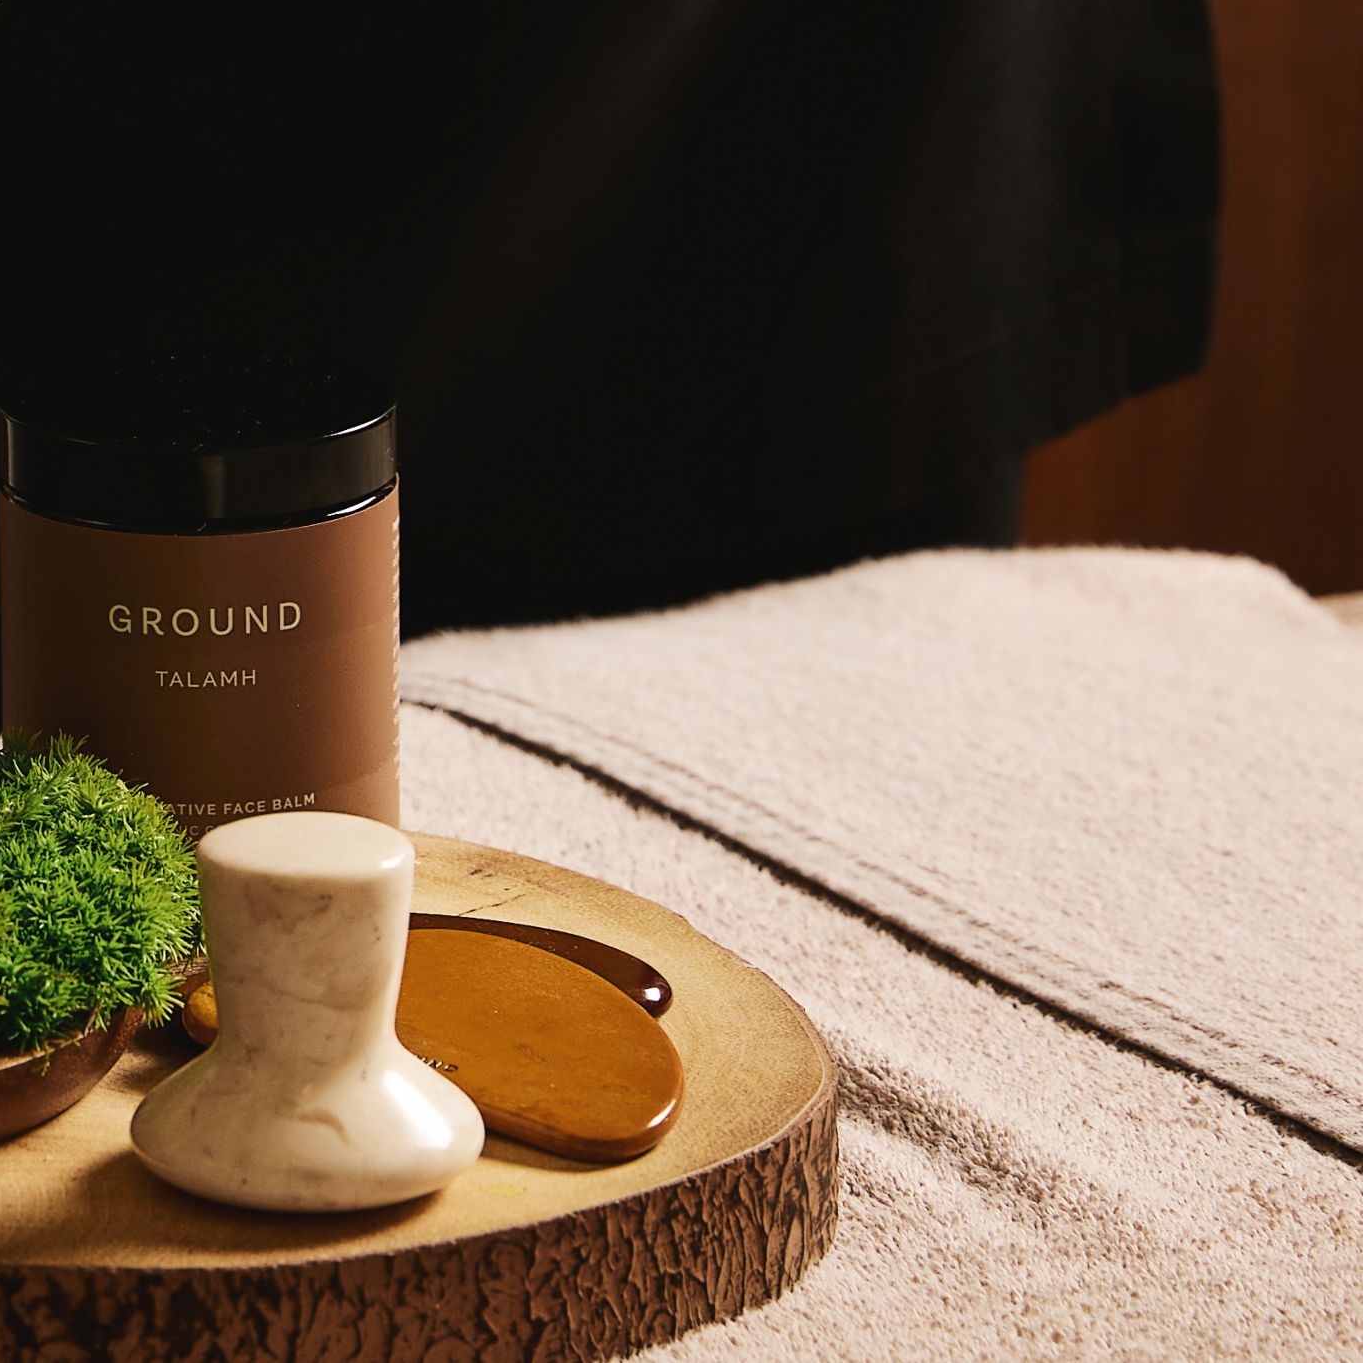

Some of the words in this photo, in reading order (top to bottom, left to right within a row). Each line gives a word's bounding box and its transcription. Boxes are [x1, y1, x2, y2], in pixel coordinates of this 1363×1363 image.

[108, 601, 302, 637] GROUND
[154, 668, 257, 688] TALAMH
[167, 803, 217, 816] ATIVE
[223, 800, 266, 815] FACE
[272, 792, 316, 811] BALM
